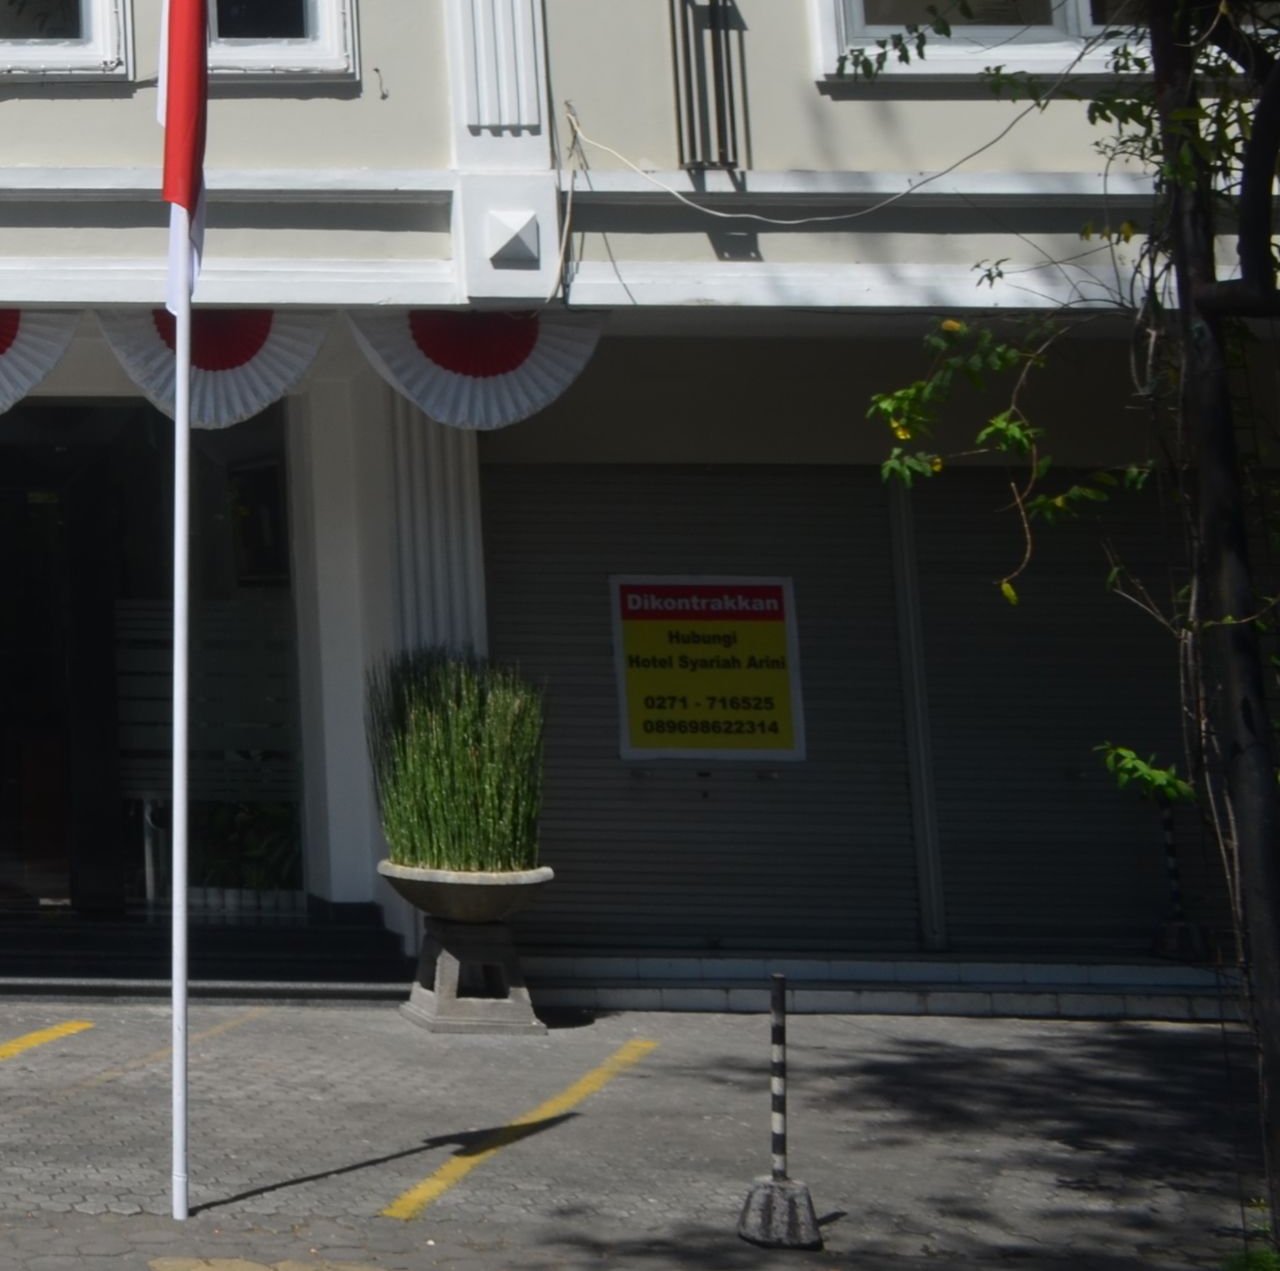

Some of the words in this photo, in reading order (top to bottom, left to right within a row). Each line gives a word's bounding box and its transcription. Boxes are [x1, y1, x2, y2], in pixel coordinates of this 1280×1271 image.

[627, 594, 779, 611] Dikontrakkan
[668, 631, 737, 647] Hubungi
[628, 656, 673, 669] Hotel
[679, 655, 741, 672] Syariah
[746, 656, 786, 669] Arini
[644, 696, 688, 709] 0271
[706, 696, 775, 710] 716525
[643, 720, 779, 734] 089698622314
